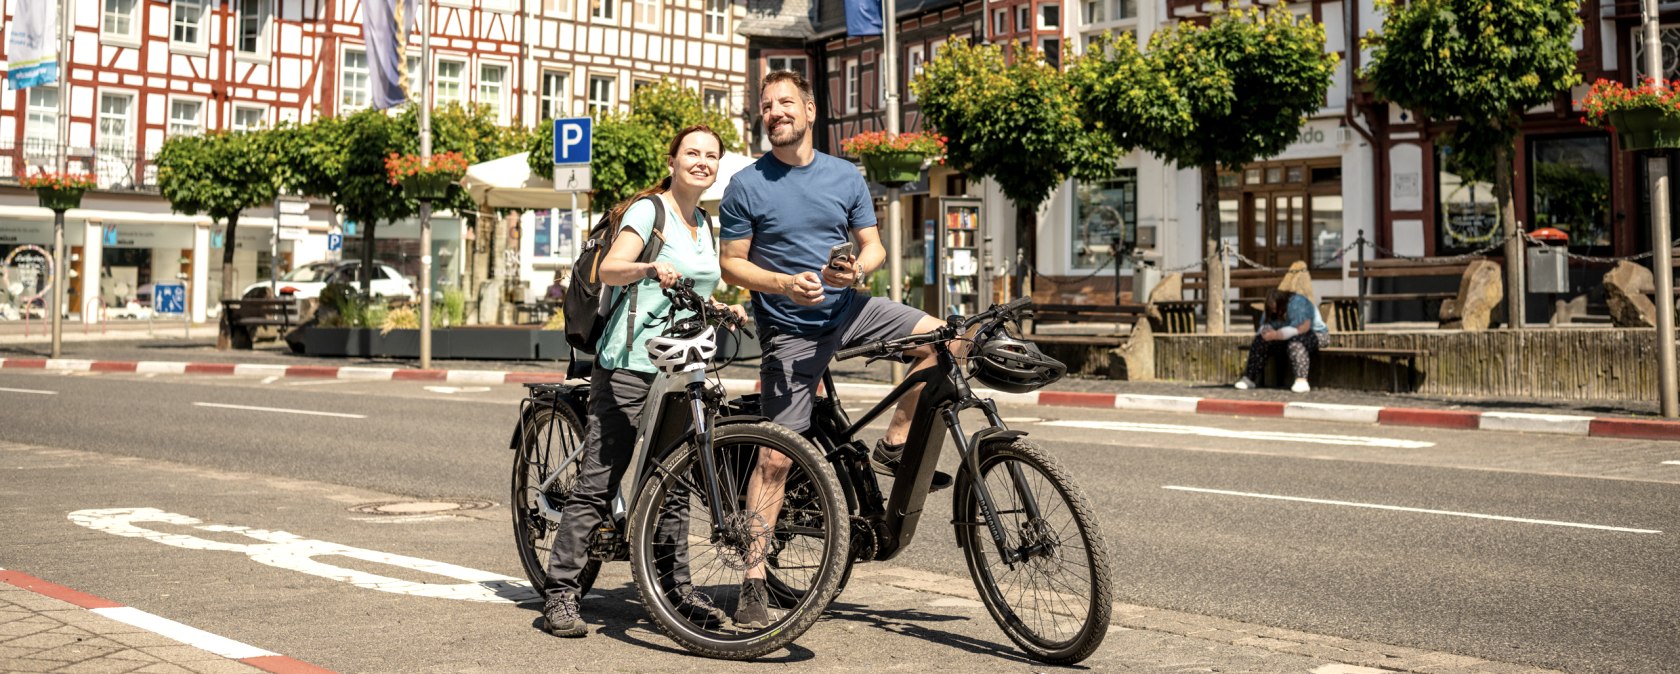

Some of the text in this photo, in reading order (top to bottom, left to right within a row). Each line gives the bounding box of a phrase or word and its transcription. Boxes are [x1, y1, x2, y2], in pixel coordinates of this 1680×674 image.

[561, 123, 583, 159] P
[331, 235, 339, 250] P
[661, 444, 696, 477] CNTINENTA
